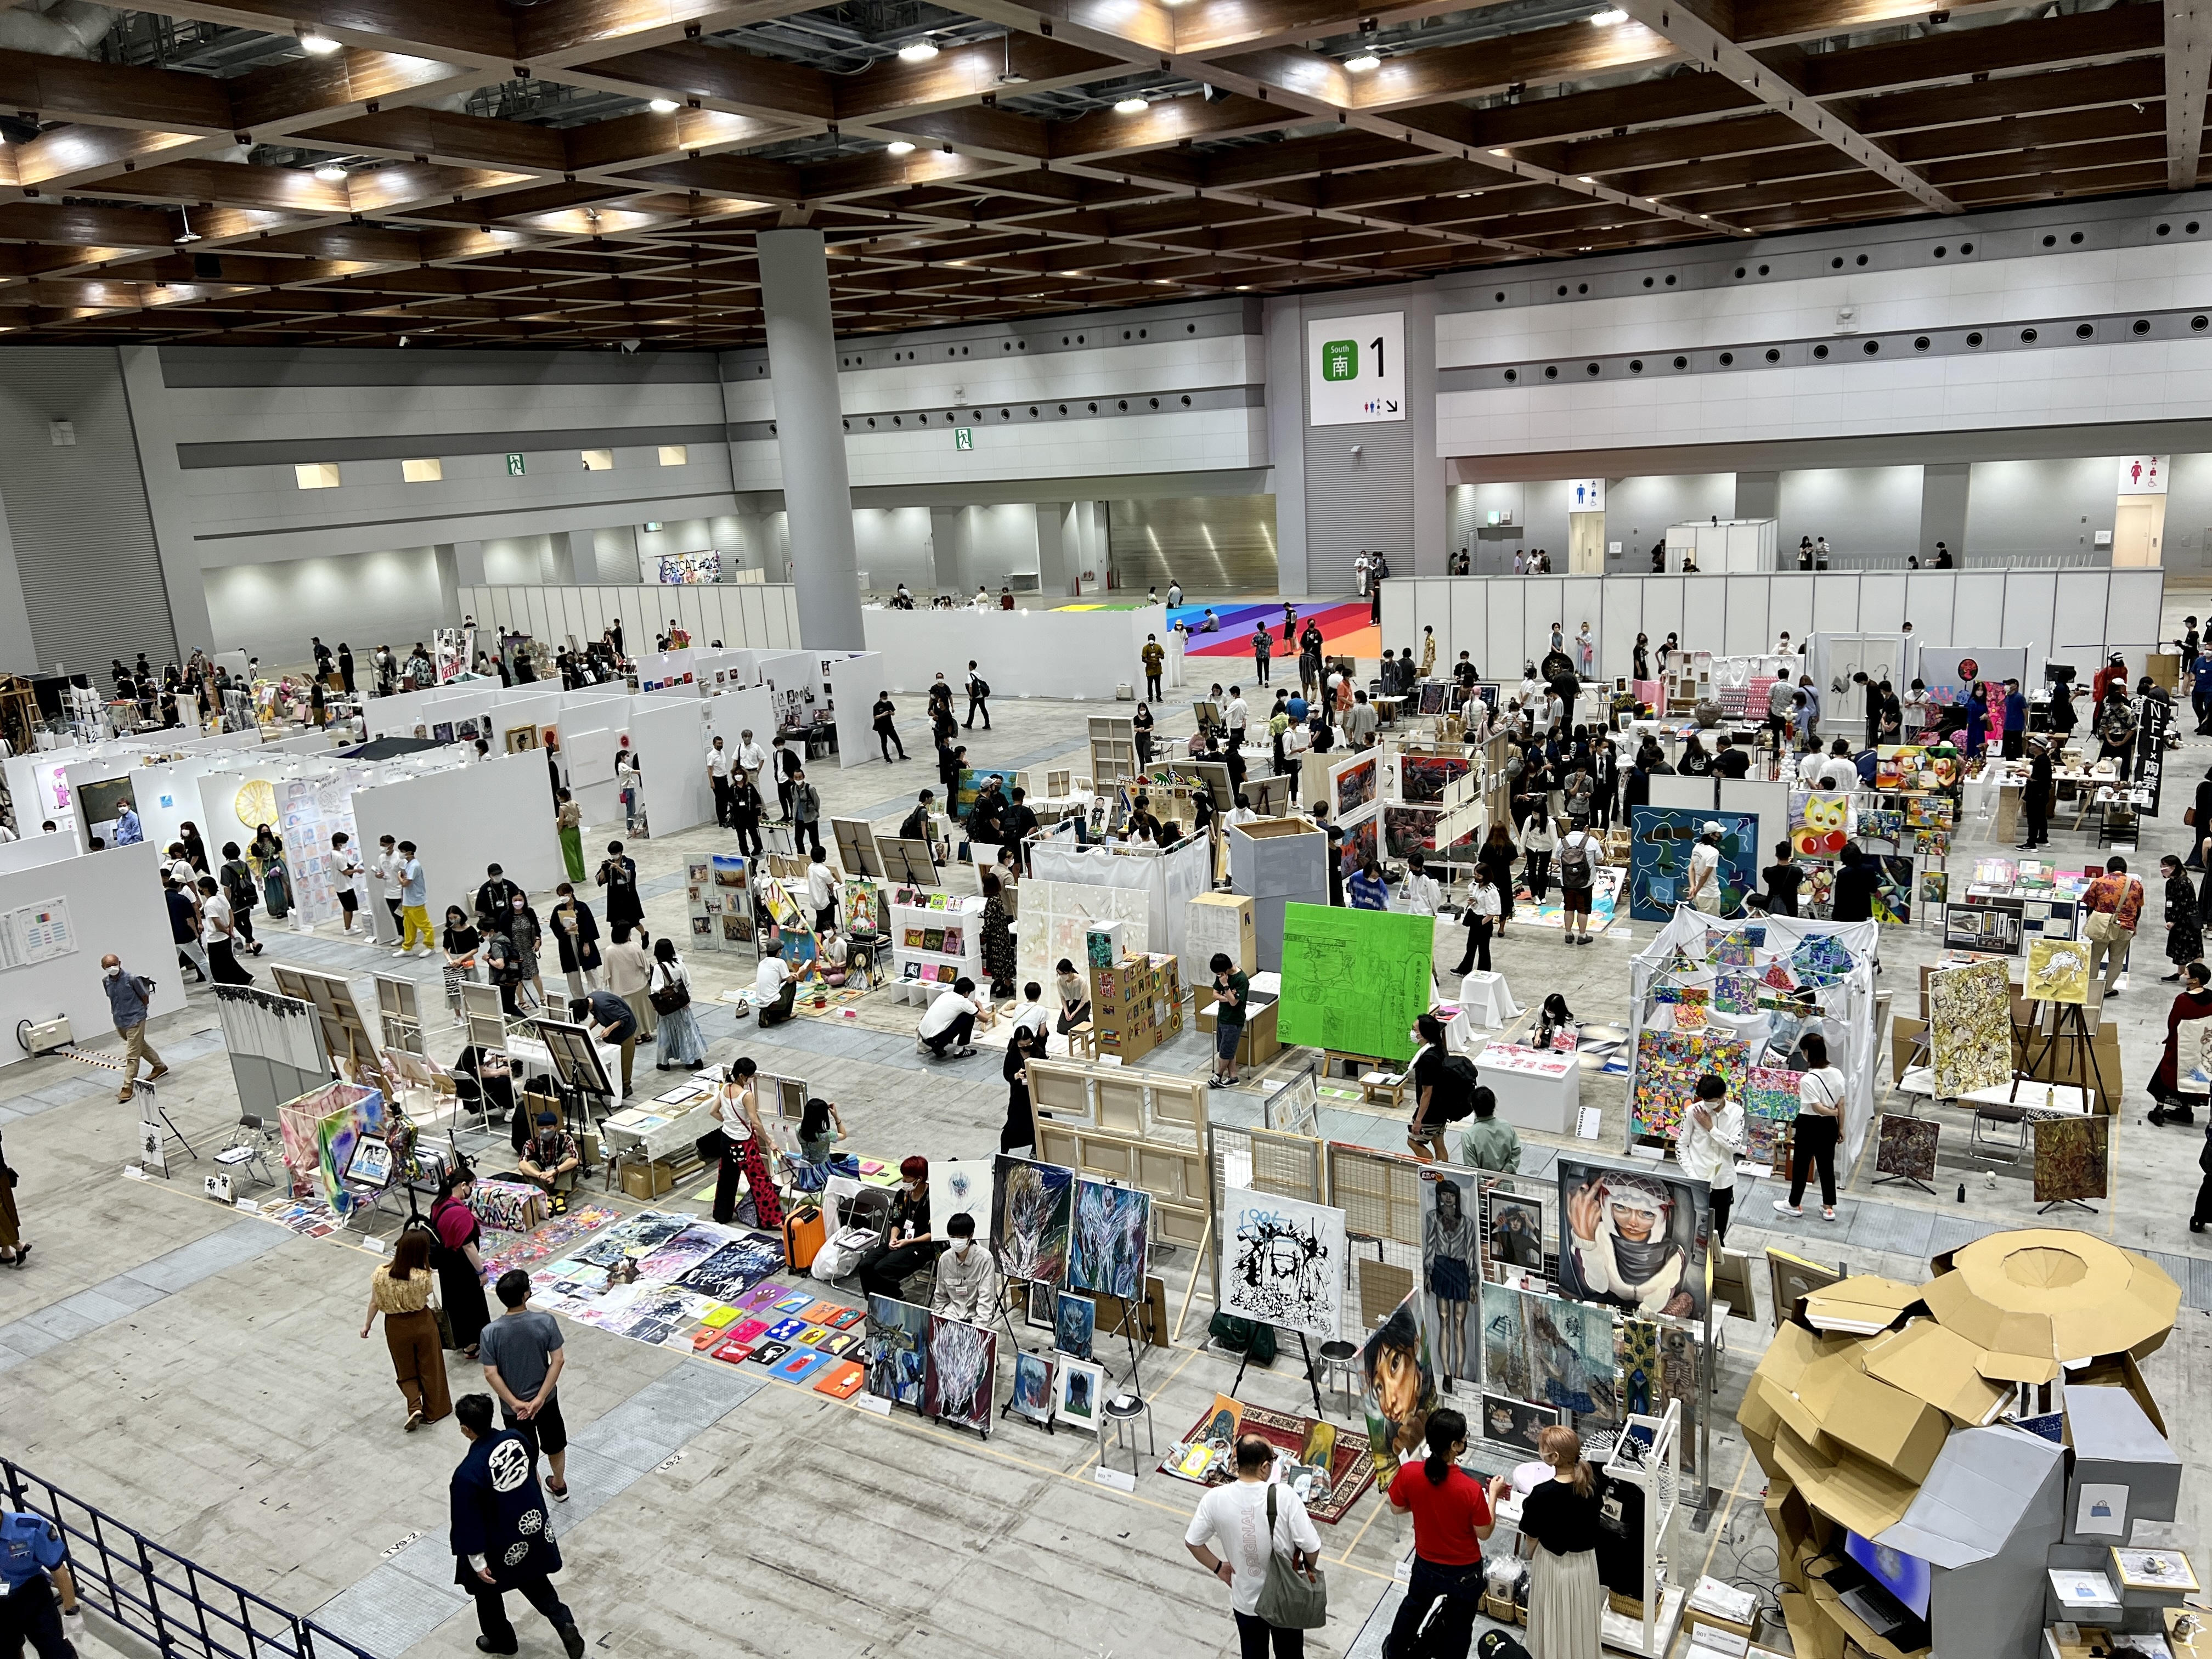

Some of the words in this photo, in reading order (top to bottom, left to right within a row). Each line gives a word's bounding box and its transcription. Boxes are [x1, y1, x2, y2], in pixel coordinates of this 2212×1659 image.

[1330, 345, 1350, 354] South
[1369, 336, 1384, 377] 1
[1332, 356, 1348, 377] 南
[662, 559, 698, 576] GEISAI
[2142, 702, 2161, 791] NFT×陶芸
[1577, 1107, 1586, 1136] PORTFOLIO
[659, 1455, 683, 1470] L9-2
[383, 1532, 419, 1555] TV9-2
[1241, 1505, 1262, 1577] ORIGINAL
